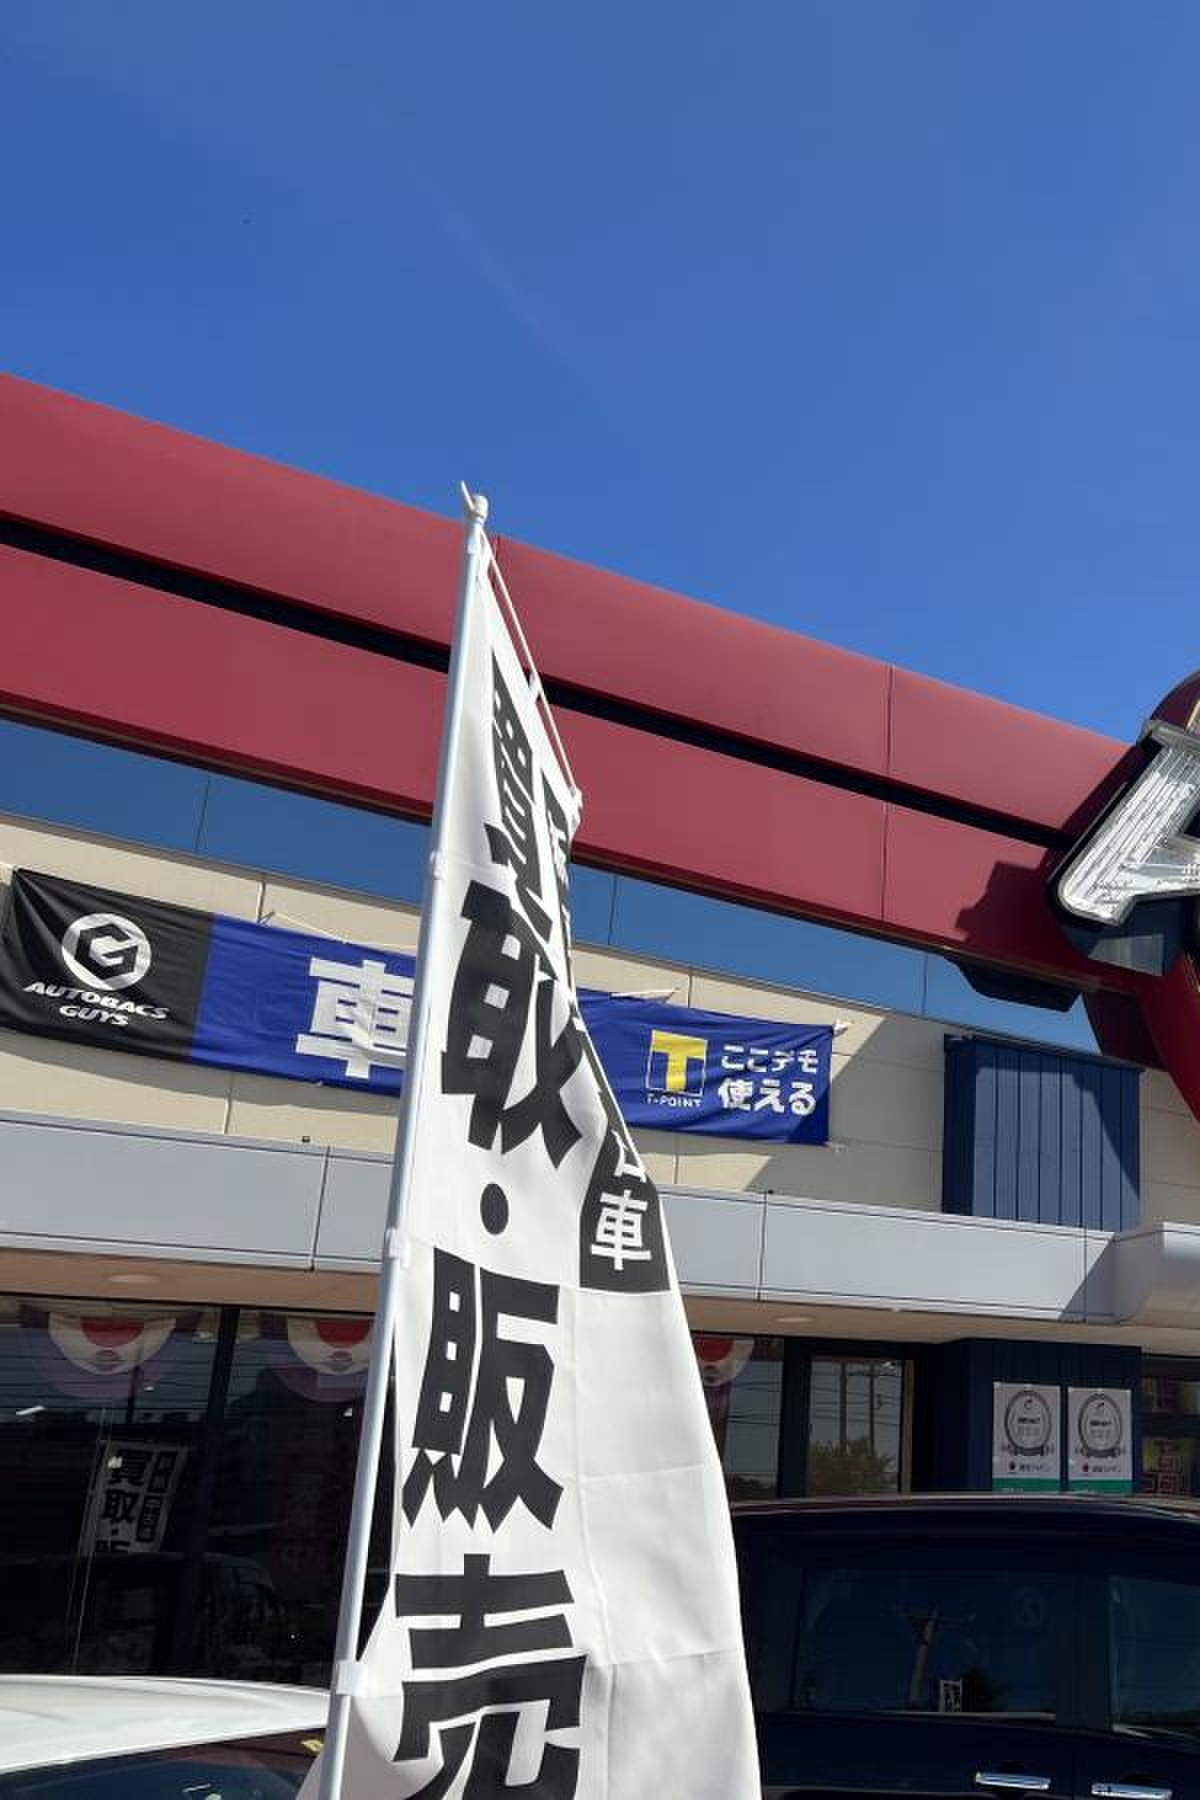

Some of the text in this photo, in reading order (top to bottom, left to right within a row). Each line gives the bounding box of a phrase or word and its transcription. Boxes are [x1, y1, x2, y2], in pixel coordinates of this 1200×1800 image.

[23, 980, 171, 1020] AUTOBACS
[58, 1004, 130, 1027] GUYS
[718, 1077, 817, 1116] 使える
